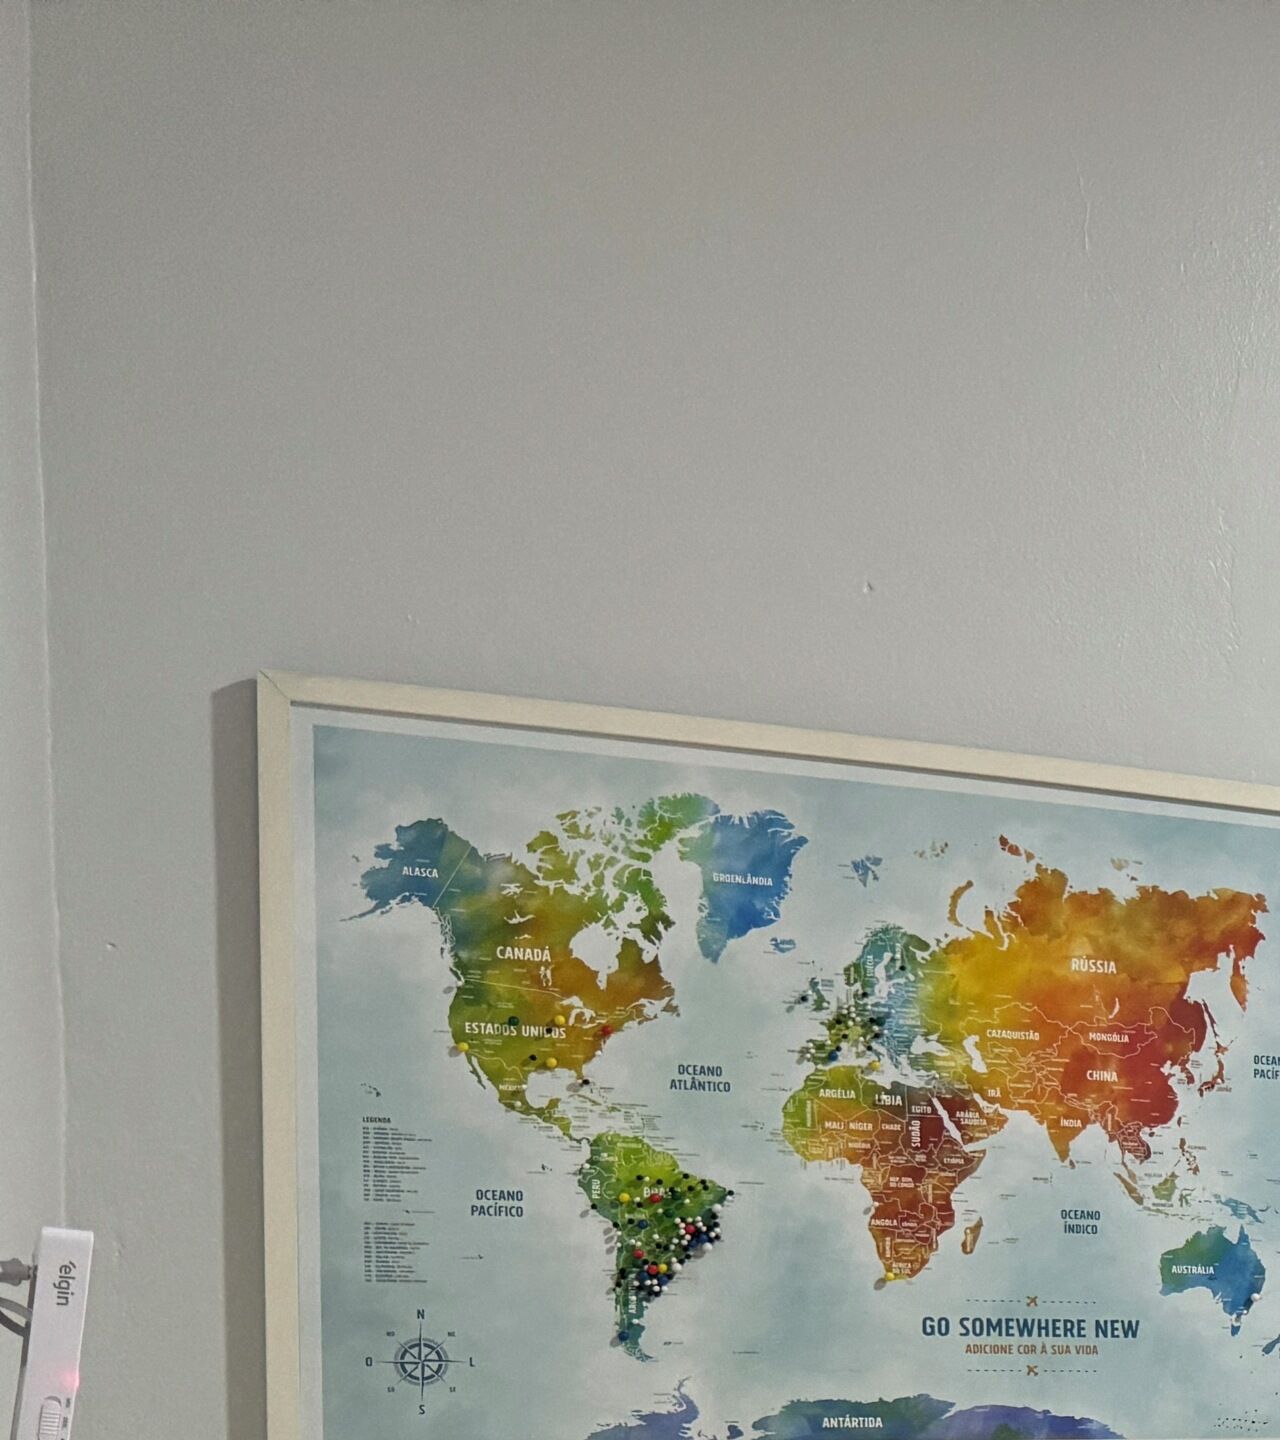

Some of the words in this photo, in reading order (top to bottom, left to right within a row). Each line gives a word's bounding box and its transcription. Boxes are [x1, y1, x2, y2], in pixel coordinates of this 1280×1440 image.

[402, 866, 439, 878] ALASCA
[712, 872, 774, 887] GROENLÂNDIA
[496, 946, 551, 962] CANADÁ
[1071, 955, 1117, 974] RÚSSIA
[465, 1022, 517, 1037] ESTADOS
[986, 1028, 1040, 1041] CAZAQUISTÃO
[1088, 1031, 1130, 1043] MONGÓLIA
[677, 1064, 723, 1077] OCEANO
[1086, 1069, 1118, 1083] CHINA
[669, 1077, 731, 1093] ATLÂNTICO
[818, 1087, 856, 1099] ARGÉLIA
[987, 1087, 1002, 1098] IRÃ
[911, 1105, 932, 1114] EGITO
[824, 1120, 844, 1130] MALI
[848, 1120, 873, 1131] NÍGER
[1060, 1115, 1082, 1128] ÍNDIA
[908, 1120, 921, 1148] SUDÃO
[475, 1189, 524, 1201] OCEANO
[592, 1179, 601, 1199] PERU
[470, 1202, 524, 1218] PACÍFICO
[1060, 1209, 1101, 1221] OCEANO
[870, 1218, 898, 1227] ANGOLA
[1064, 1221, 1098, 1235] ÍNDICO
[1171, 1263, 1215, 1275] AUSTRÁLIA
[53, 1262, 77, 1306] elgin
[416, 1308, 425, 1320] N
[921, 1316, 950, 1337] GO
[958, 1317, 1087, 1338] SOMEWHERE
[1094, 1319, 1140, 1339] NEW
[965, 1343, 1014, 1355] ADICIONE
[1017, 1344, 1037, 1355] COR
[1040, 1341, 1048, 1355] À
[1051, 1344, 1072, 1355] SUA
[1075, 1344, 1099, 1355] VIDA
[365, 1356, 373, 1367] O
[469, 1356, 476, 1367] L
[418, 1404, 426, 1415] S
[822, 1414, 884, 1428] ANTÁRTIDA
